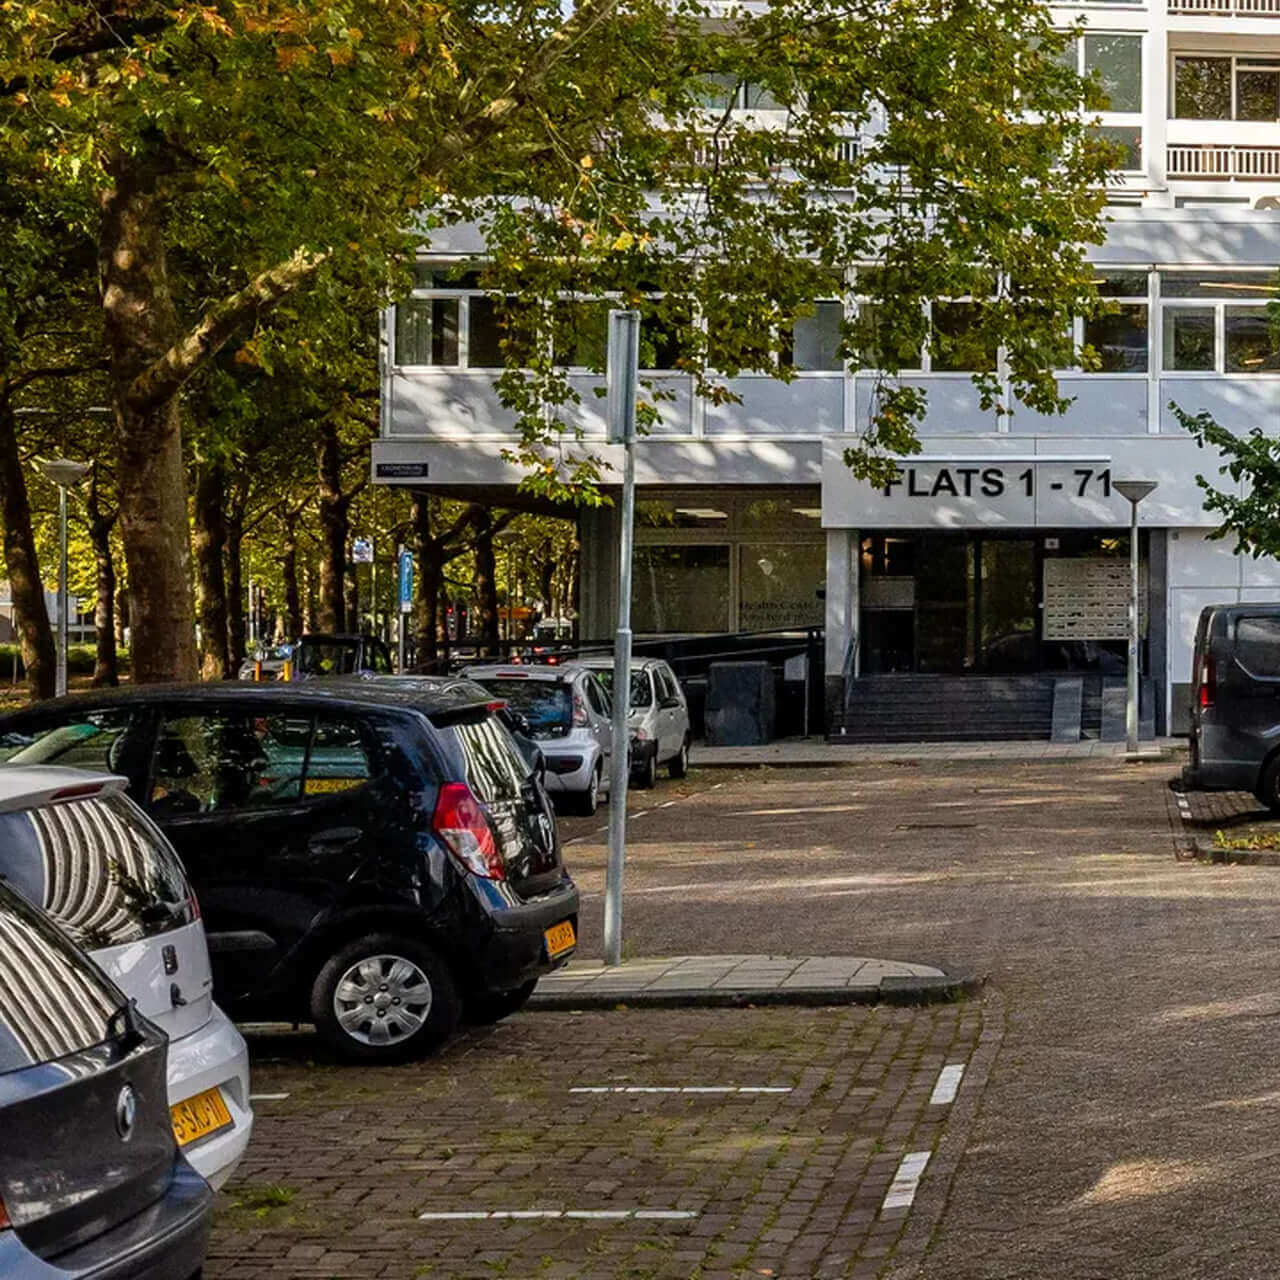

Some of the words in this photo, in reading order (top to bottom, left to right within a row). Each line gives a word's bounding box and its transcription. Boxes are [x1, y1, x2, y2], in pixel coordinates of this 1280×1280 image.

[884, 468, 1004, 497] FLATS
[1019, 468, 1034, 497] 1
[1073, 469, 1112, 497] 71
